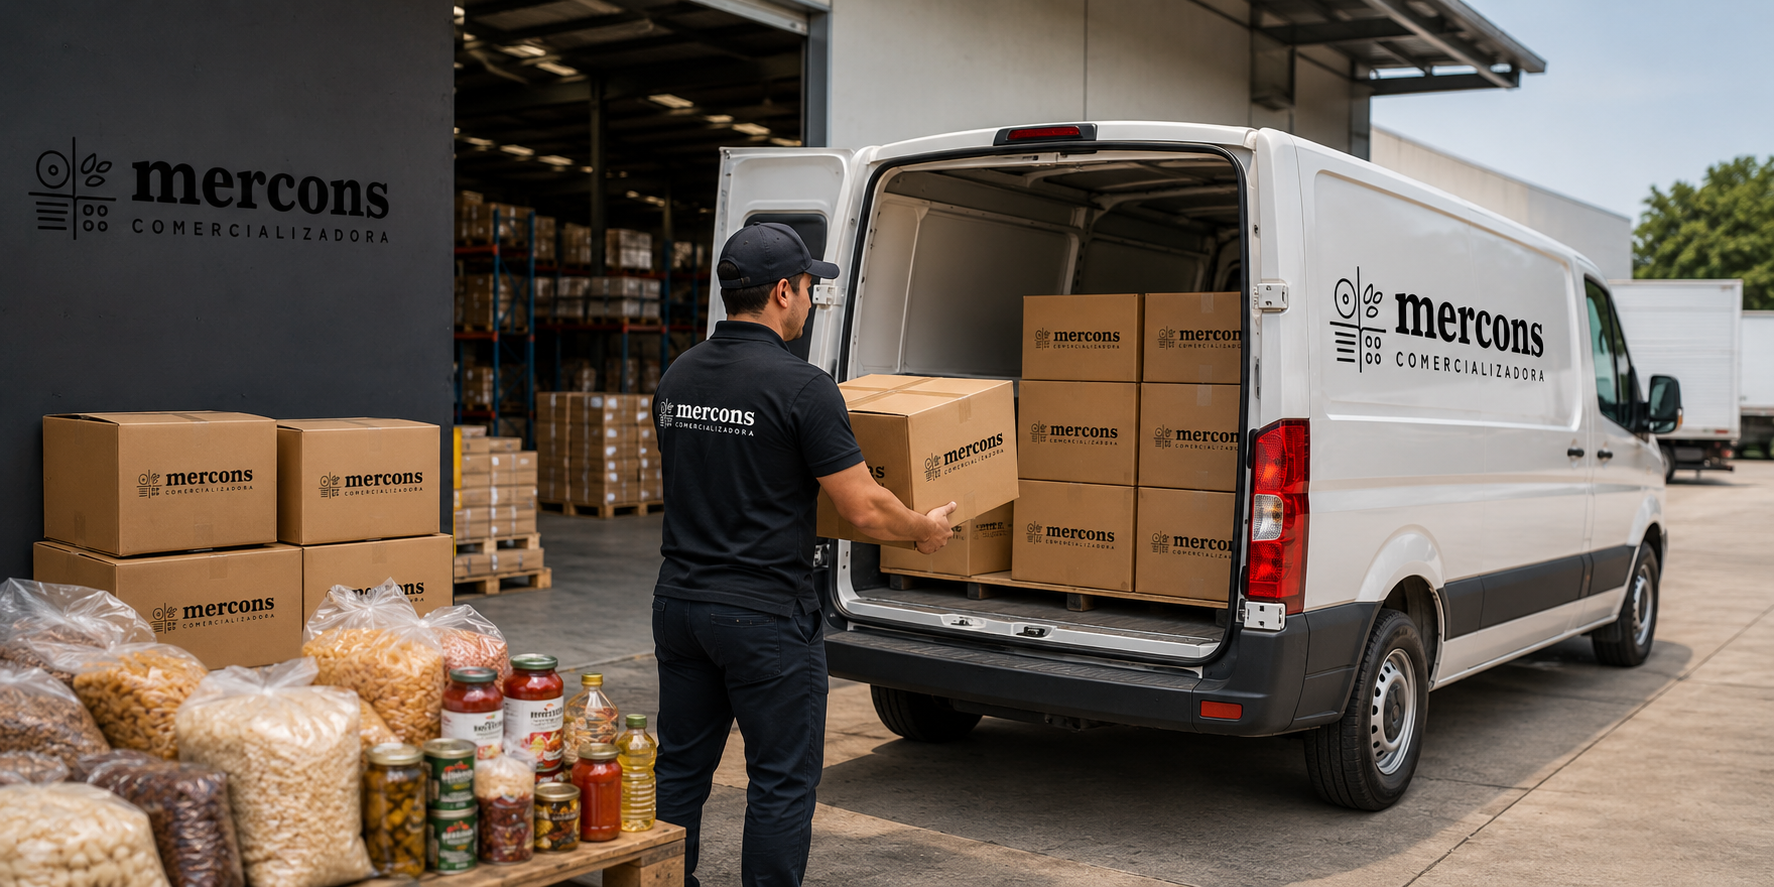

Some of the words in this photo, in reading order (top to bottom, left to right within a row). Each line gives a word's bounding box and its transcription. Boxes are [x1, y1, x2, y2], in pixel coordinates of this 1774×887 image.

[131, 160, 390, 220] mercons
[131, 218, 389, 244] COMERCIALIZADORA
[1394, 292, 1544, 358] mercons
[1053, 330, 1121, 343] mercons
[1179, 329, 1242, 342] mercon
[1395, 351, 1545, 383] COMERCIALIZADORA
[675, 403, 755, 427] mercons
[674, 421, 755, 437] COMERCIALIZADORA
[1050, 424, 1119, 439] mercons
[1175, 429, 1239, 444] mercon
[943, 432, 1004, 466] mercons
[165, 468, 254, 487] mercons
[344, 471, 424, 488] mercons
[1046, 525, 1116, 543] mercons
[1173, 534, 1234, 552] merco
[182, 596, 275, 620] mercons
